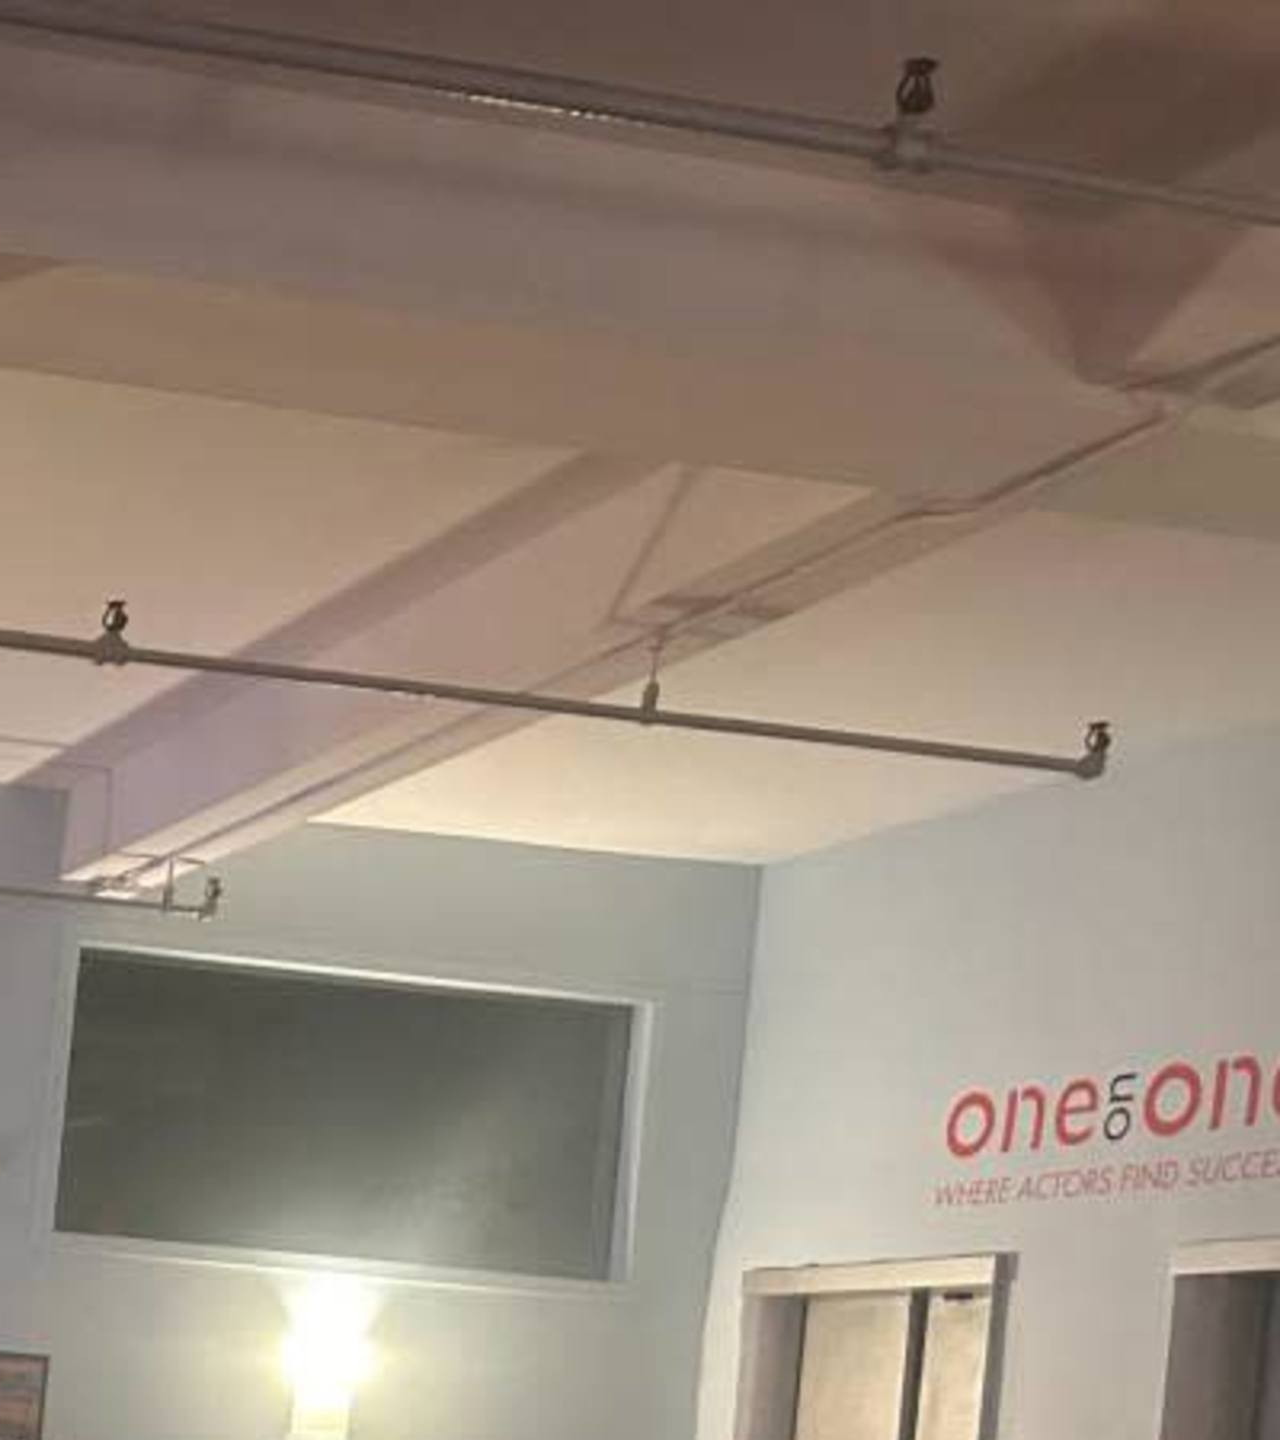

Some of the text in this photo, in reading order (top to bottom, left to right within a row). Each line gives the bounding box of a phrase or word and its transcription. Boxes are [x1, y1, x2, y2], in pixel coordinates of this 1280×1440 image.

[946, 1055, 1280, 1157] one on on
[935, 1147, 1280, 1206] WHERE ACTORS FIND SUCCE
